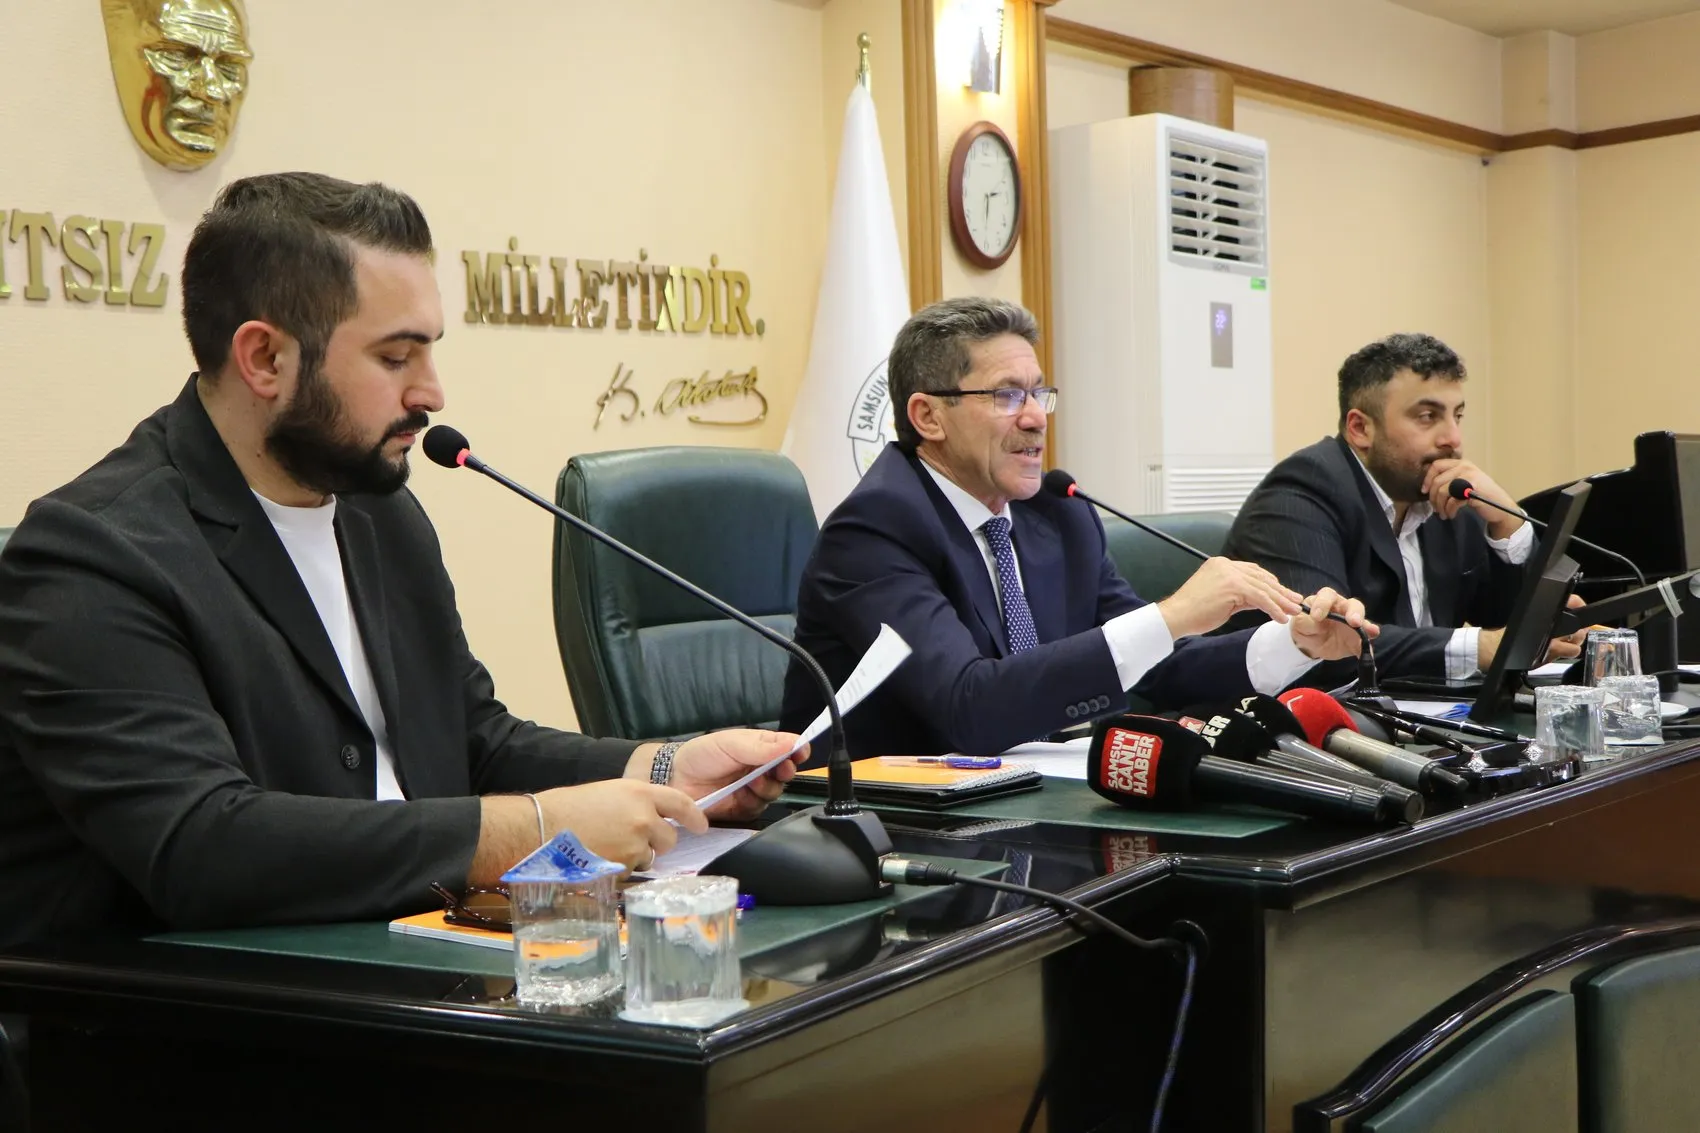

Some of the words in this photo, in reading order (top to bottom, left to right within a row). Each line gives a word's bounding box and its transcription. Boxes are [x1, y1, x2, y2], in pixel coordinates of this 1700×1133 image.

[461, 236, 766, 336] MİLLETİNDİR.
[1107, 730, 1126, 789] SAMSUN
[1117, 733, 1140, 791] CANLI
[1133, 735, 1156, 795] HABER
